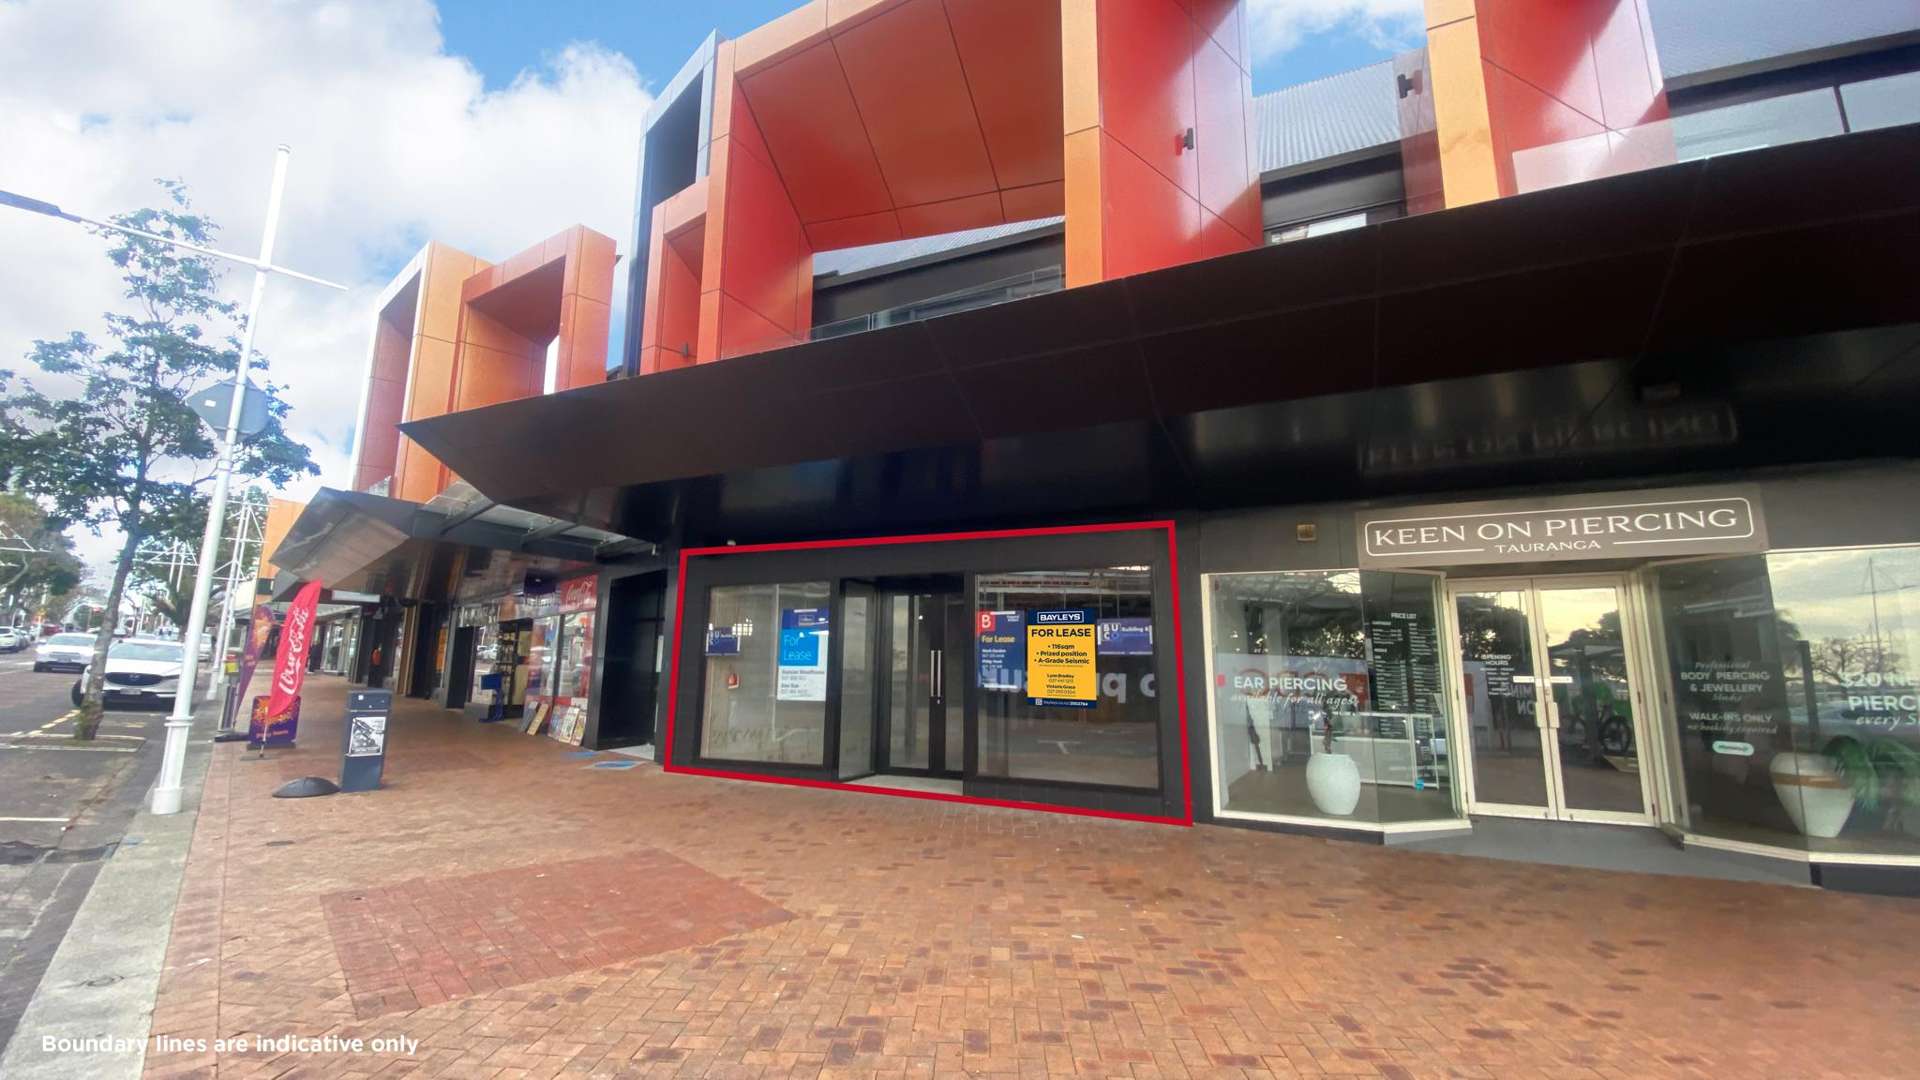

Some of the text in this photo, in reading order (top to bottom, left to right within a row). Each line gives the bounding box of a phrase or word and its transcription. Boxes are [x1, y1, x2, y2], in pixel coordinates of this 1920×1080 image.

[1375, 509, 1738, 546] KEEN ON PIERCING
[1494, 540, 1602, 554] TAURANGA
[981, 614, 992, 628] B
[1040, 613, 1081, 621] BAYLEYS
[1031, 628, 1091, 637] FOR LEASE
[783, 634, 800, 646] For
[783, 649, 812, 661] Lease
[1061, 650, 1088, 658] position
[1065, 657, 1089, 665] Seismic
[1680, 671, 1770, 681] BODY PIERCING
[1233, 676, 1348, 691] EAR PIERCING
[1689, 683, 1763, 693] & JEWELLERY
[1283, 691, 1303, 707] for
[1306, 691, 1326, 704] all
[1688, 711, 1773, 722] WALK-INS ONLY
[1855, 716, 1901, 732] every
